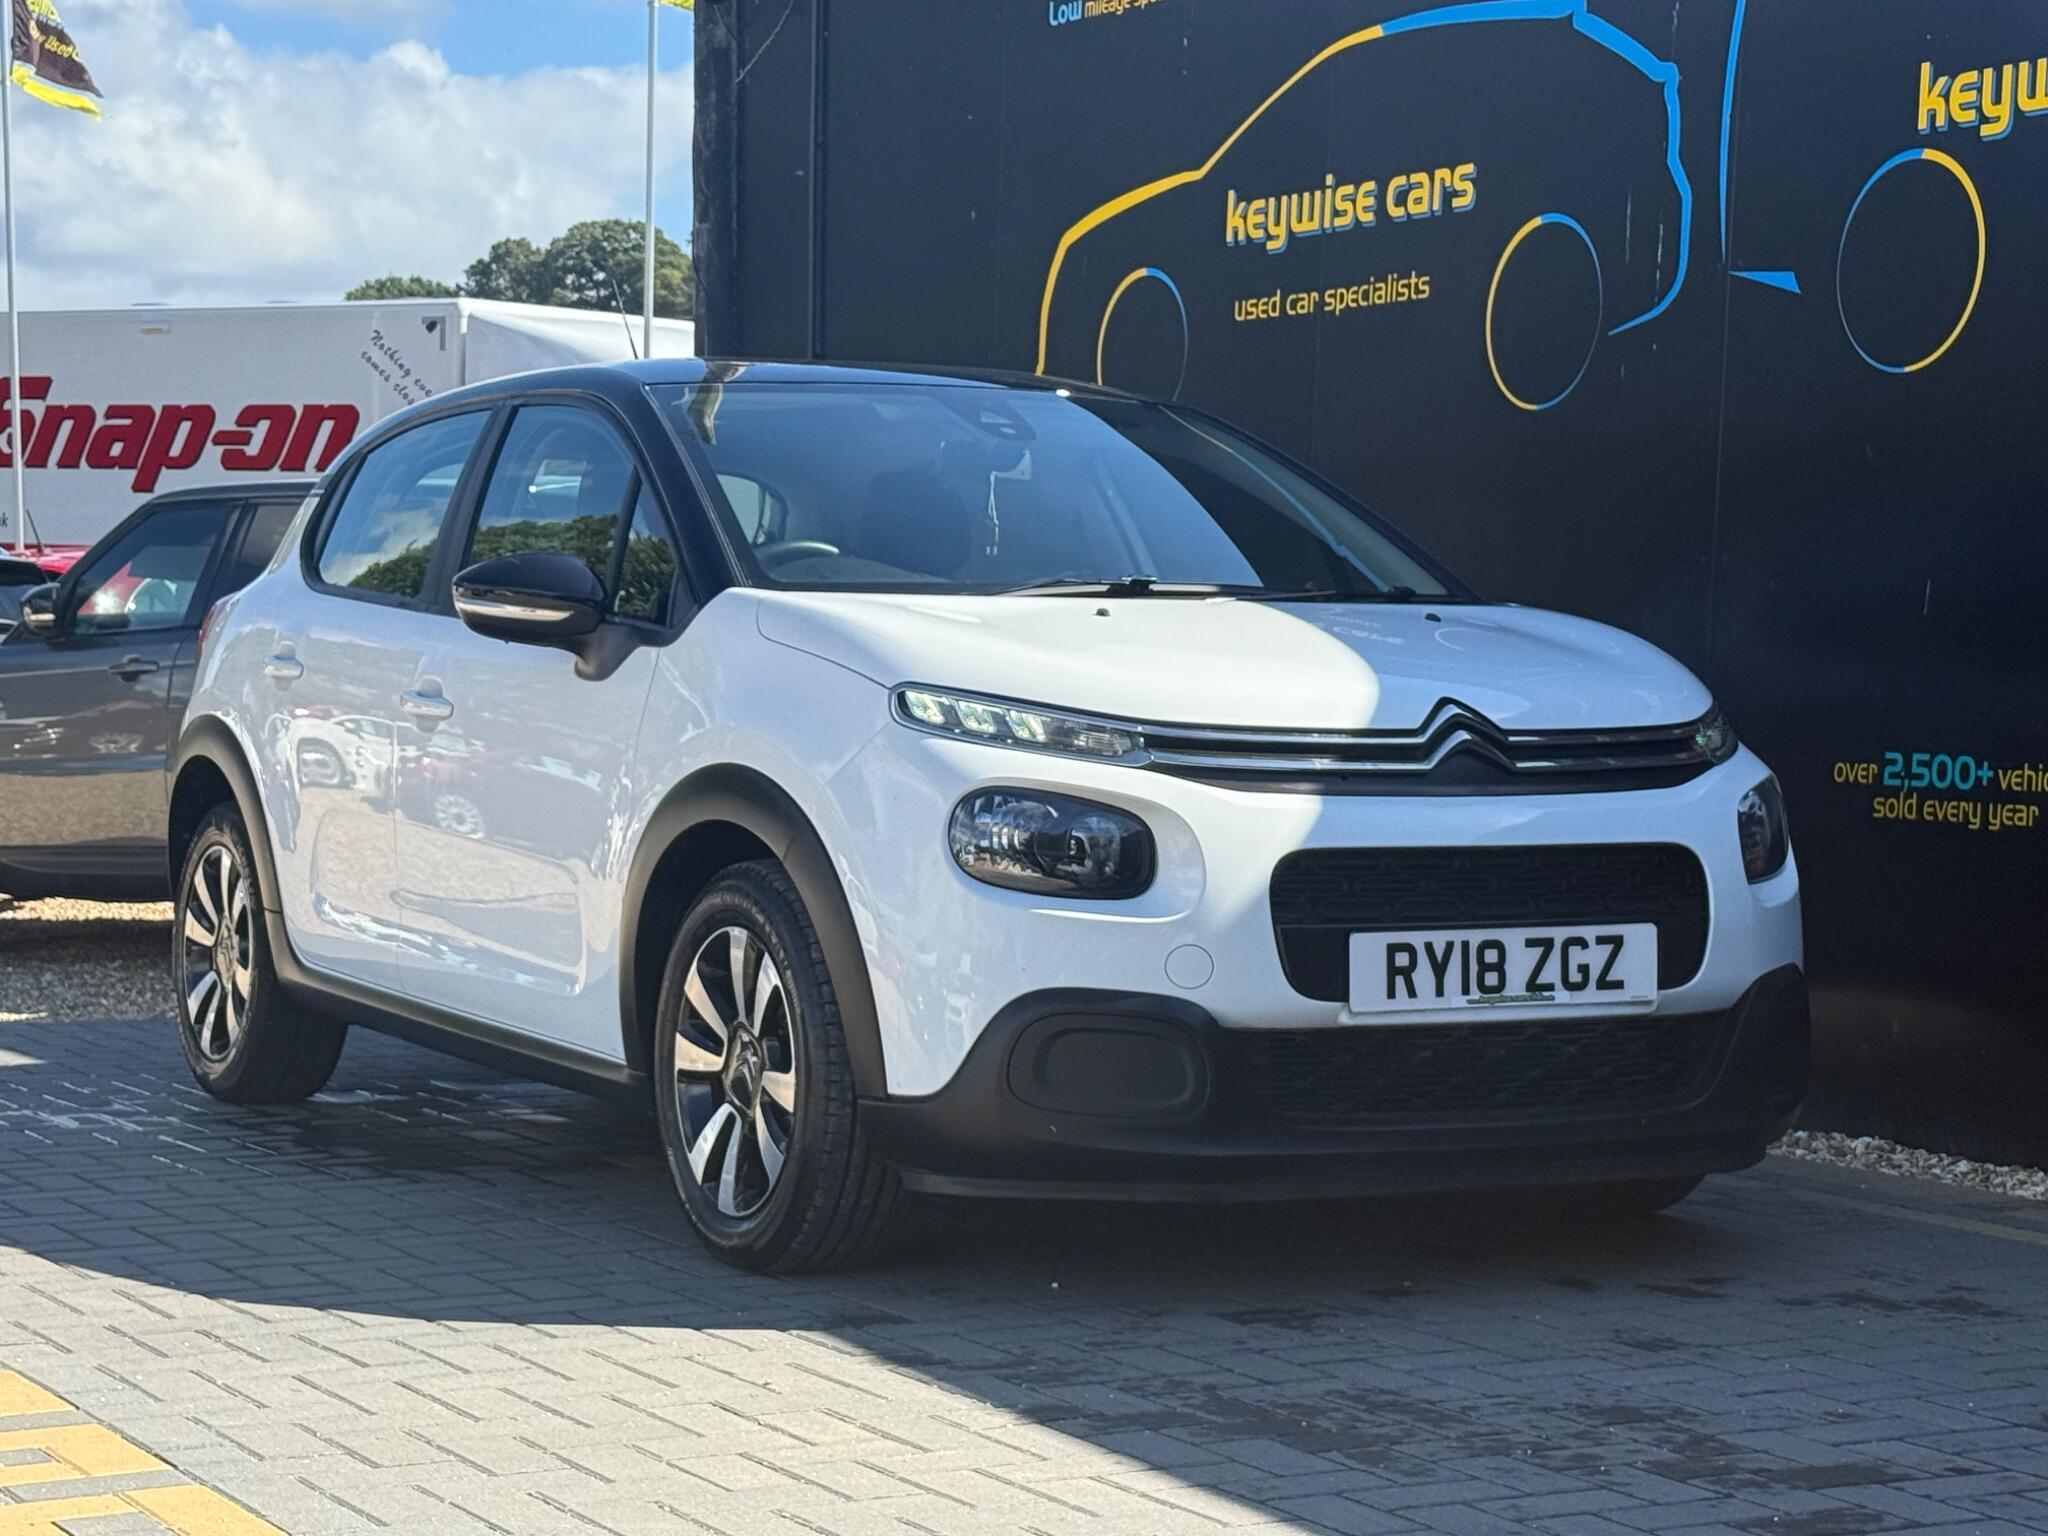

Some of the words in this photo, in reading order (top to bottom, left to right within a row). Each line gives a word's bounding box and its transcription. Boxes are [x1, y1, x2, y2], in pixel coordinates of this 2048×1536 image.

[1049, 0, 1082, 26] Low
[1226, 173, 1378, 254] keywise
[1386, 163, 1477, 222] cars
[1234, 289, 1281, 321] used
[1286, 292, 1319, 315] car
[1323, 270, 1431, 316] specialists
[361, 350, 391, 382] comes
[371, 329, 412, 380] Nothing
[0, 376, 360, 493] Snap-on
[1833, 762, 1878, 784] over
[1882, 751, 1994, 793] 2,500+
[1872, 792, 1917, 820] sold
[1923, 799, 1981, 829] every
[1988, 803, 2039, 831] year
[1386, 938, 1507, 1000] RY18
[1524, 934, 1625, 993] ZGZ
